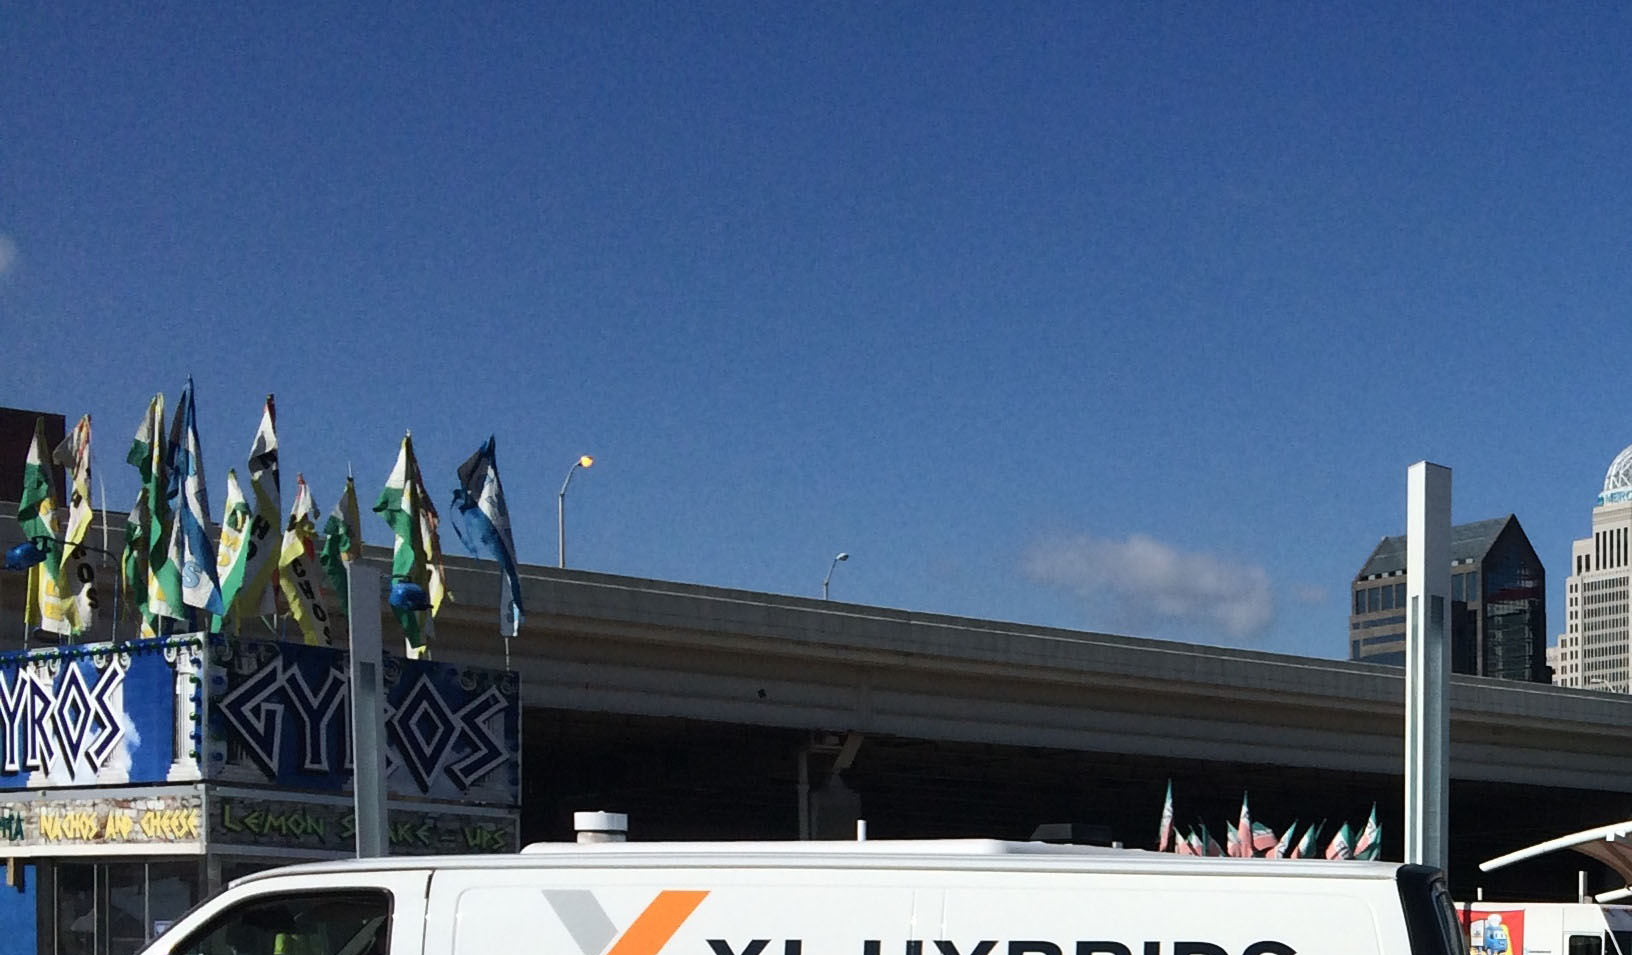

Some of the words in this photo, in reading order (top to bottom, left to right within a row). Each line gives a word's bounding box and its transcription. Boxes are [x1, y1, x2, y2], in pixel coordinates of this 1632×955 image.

[217, 654, 511, 788] GYOS
[39, 810, 98, 841] NACHOS
[104, 809, 134, 840] AND
[140, 807, 199, 839] CHEESE
[222, 803, 325, 844] LEMON
[339, 813, 430, 847] SAKE
